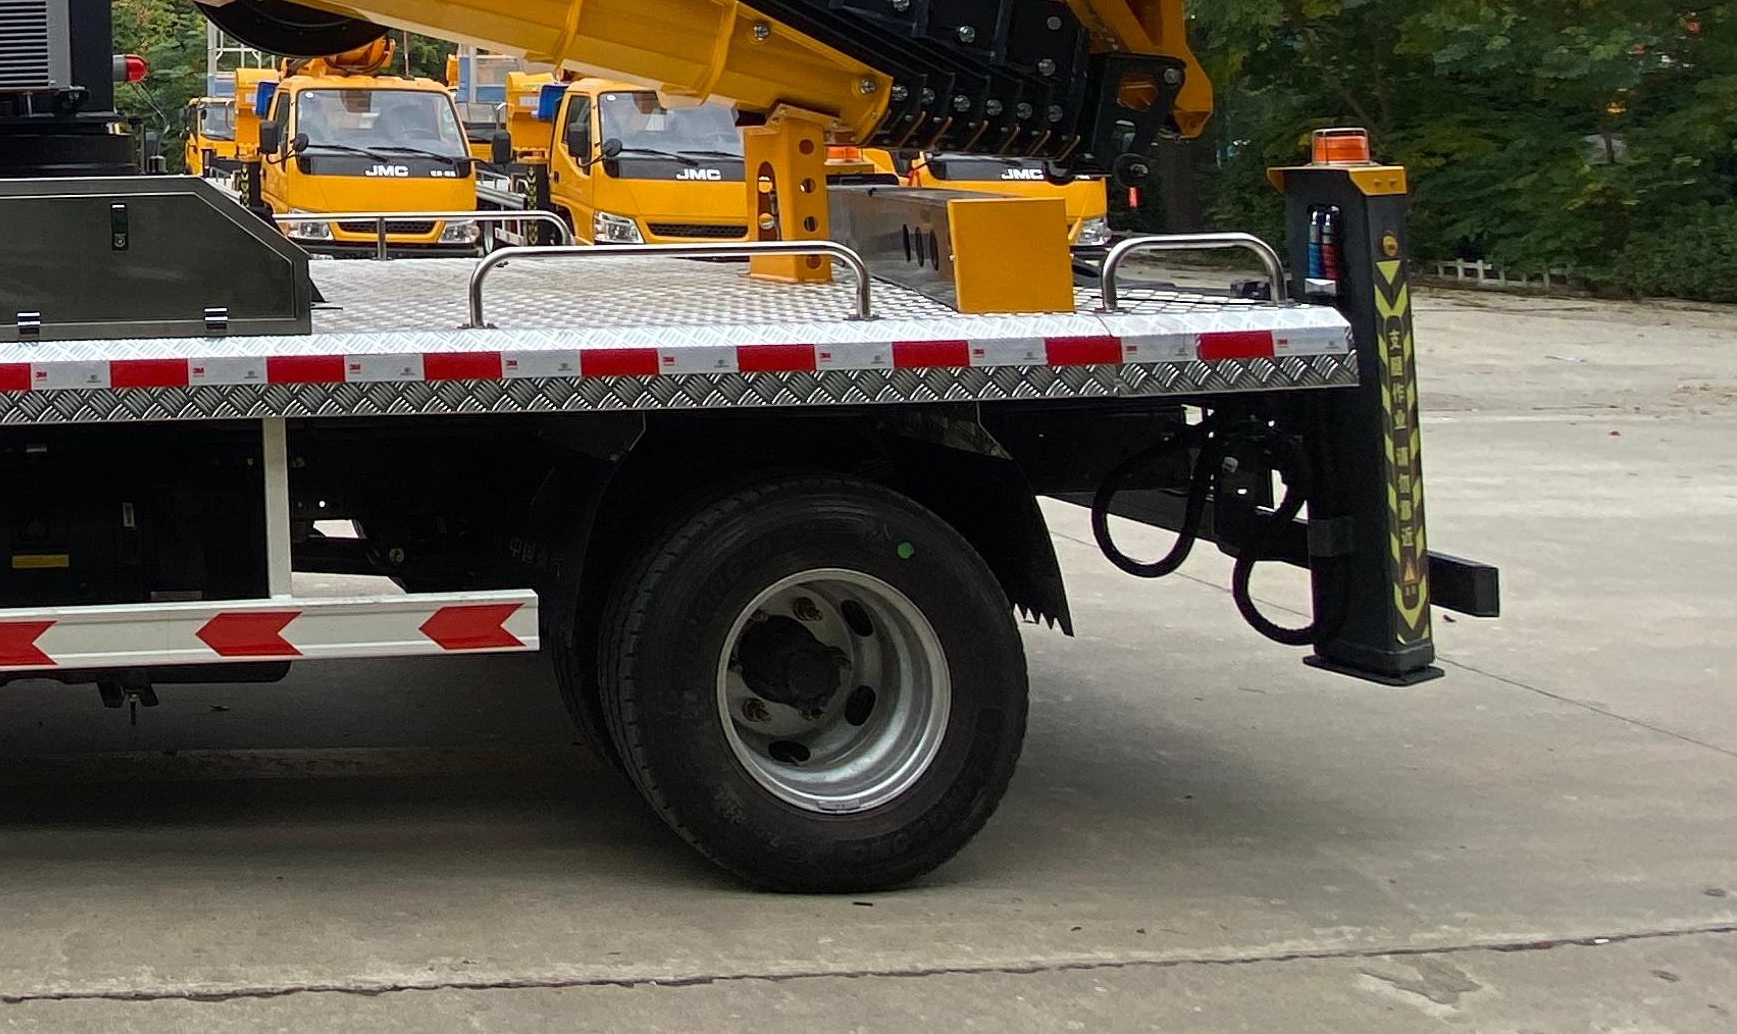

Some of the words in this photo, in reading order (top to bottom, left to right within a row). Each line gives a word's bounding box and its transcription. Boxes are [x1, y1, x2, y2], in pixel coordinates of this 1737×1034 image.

[364, 165, 410, 177] JMC
[675, 168, 722, 181] JMC
[1001, 168, 1044, 180] JMC
